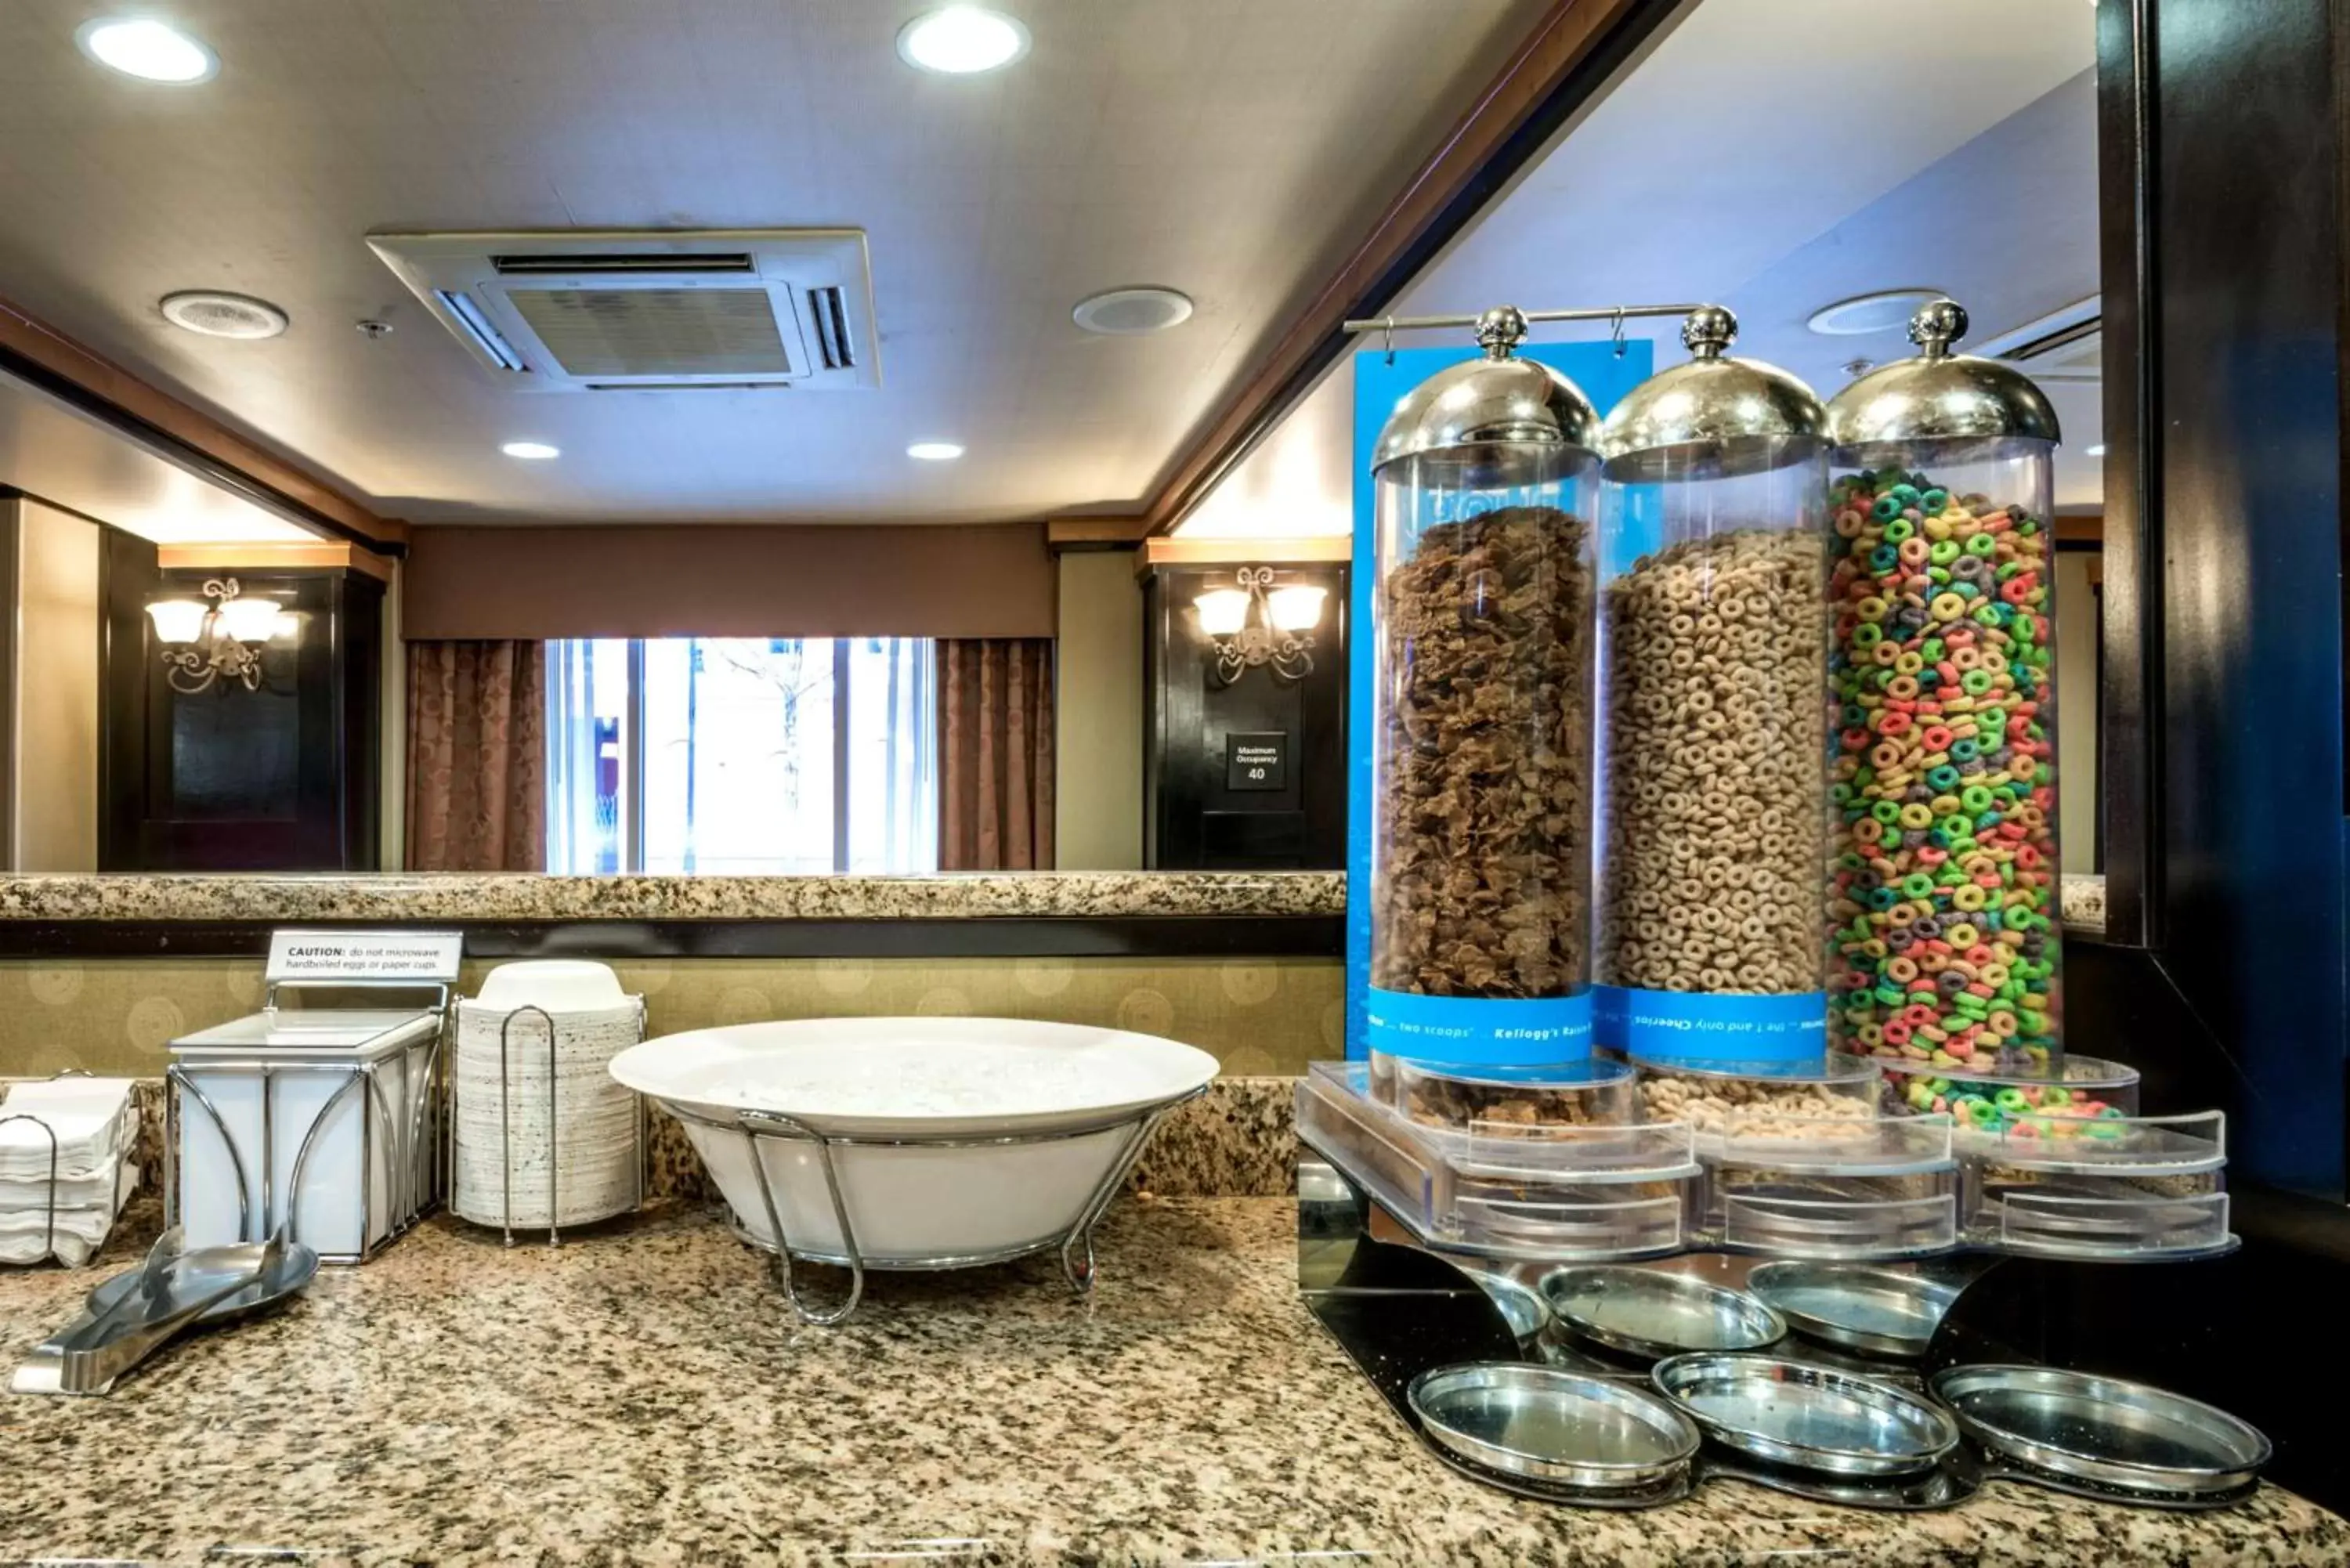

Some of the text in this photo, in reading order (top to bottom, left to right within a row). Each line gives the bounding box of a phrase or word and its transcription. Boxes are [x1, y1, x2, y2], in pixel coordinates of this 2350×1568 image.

[1249, 768, 1265, 779] 40
[349, 948, 363, 956] do
[385, 948, 440, 957] microwave
[286, 959, 340, 969] hardboiled
[343, 961, 366, 970] eggs
[381, 961, 410, 970] paper
[1399, 1022, 1420, 1033] two
[1694, 1019, 1725, 1033] only
[1727, 1020, 1753, 1031] and
